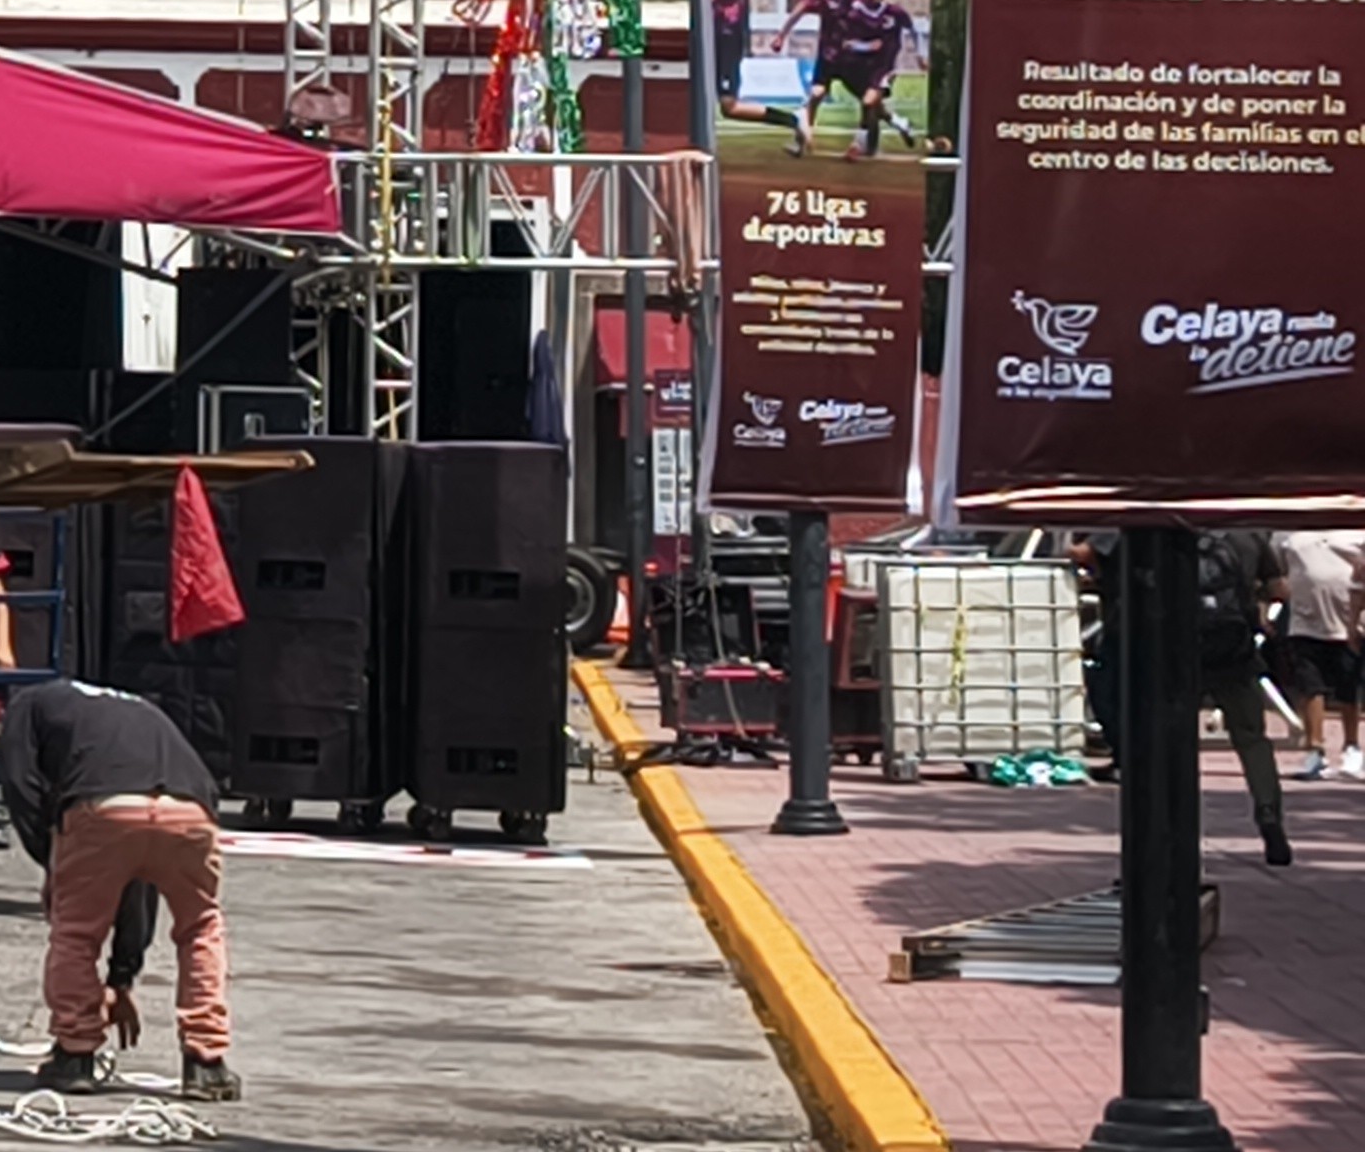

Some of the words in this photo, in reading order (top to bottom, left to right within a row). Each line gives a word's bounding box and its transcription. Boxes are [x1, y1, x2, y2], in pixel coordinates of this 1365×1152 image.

[1023, 60, 1144, 83] Resultado
[1150, 62, 1181, 83] de
[1188, 63, 1312, 86] fortalecer
[1318, 65, 1341, 86] la
[1018, 89, 1176, 113] coordinación
[1181, 96, 1197, 117] y
[1202, 93, 1236, 114] de
[1242, 97, 1317, 118] poner
[1323, 95, 1346, 115] la
[996, 118, 1117, 144] seguridad
[1123, 121, 1155, 141] de
[1161, 121, 1196, 142] las
[1202, 122, 1302, 144] familias
[1307, 127, 1339, 144] en
[1028, 150, 1109, 169] centro
[1114, 149, 1146, 170] de
[1152, 150, 1187, 171] las
[1193, 151, 1334, 173] decisiones.
[766, 190, 800, 216] 76
[806, 189, 867, 225] ligas
[742, 215, 886, 249] deportivas
[1140, 303, 1282, 345] Celaya
[997, 356, 1112, 387] Celaya
[1199, 331, 1356, 381] detiene
